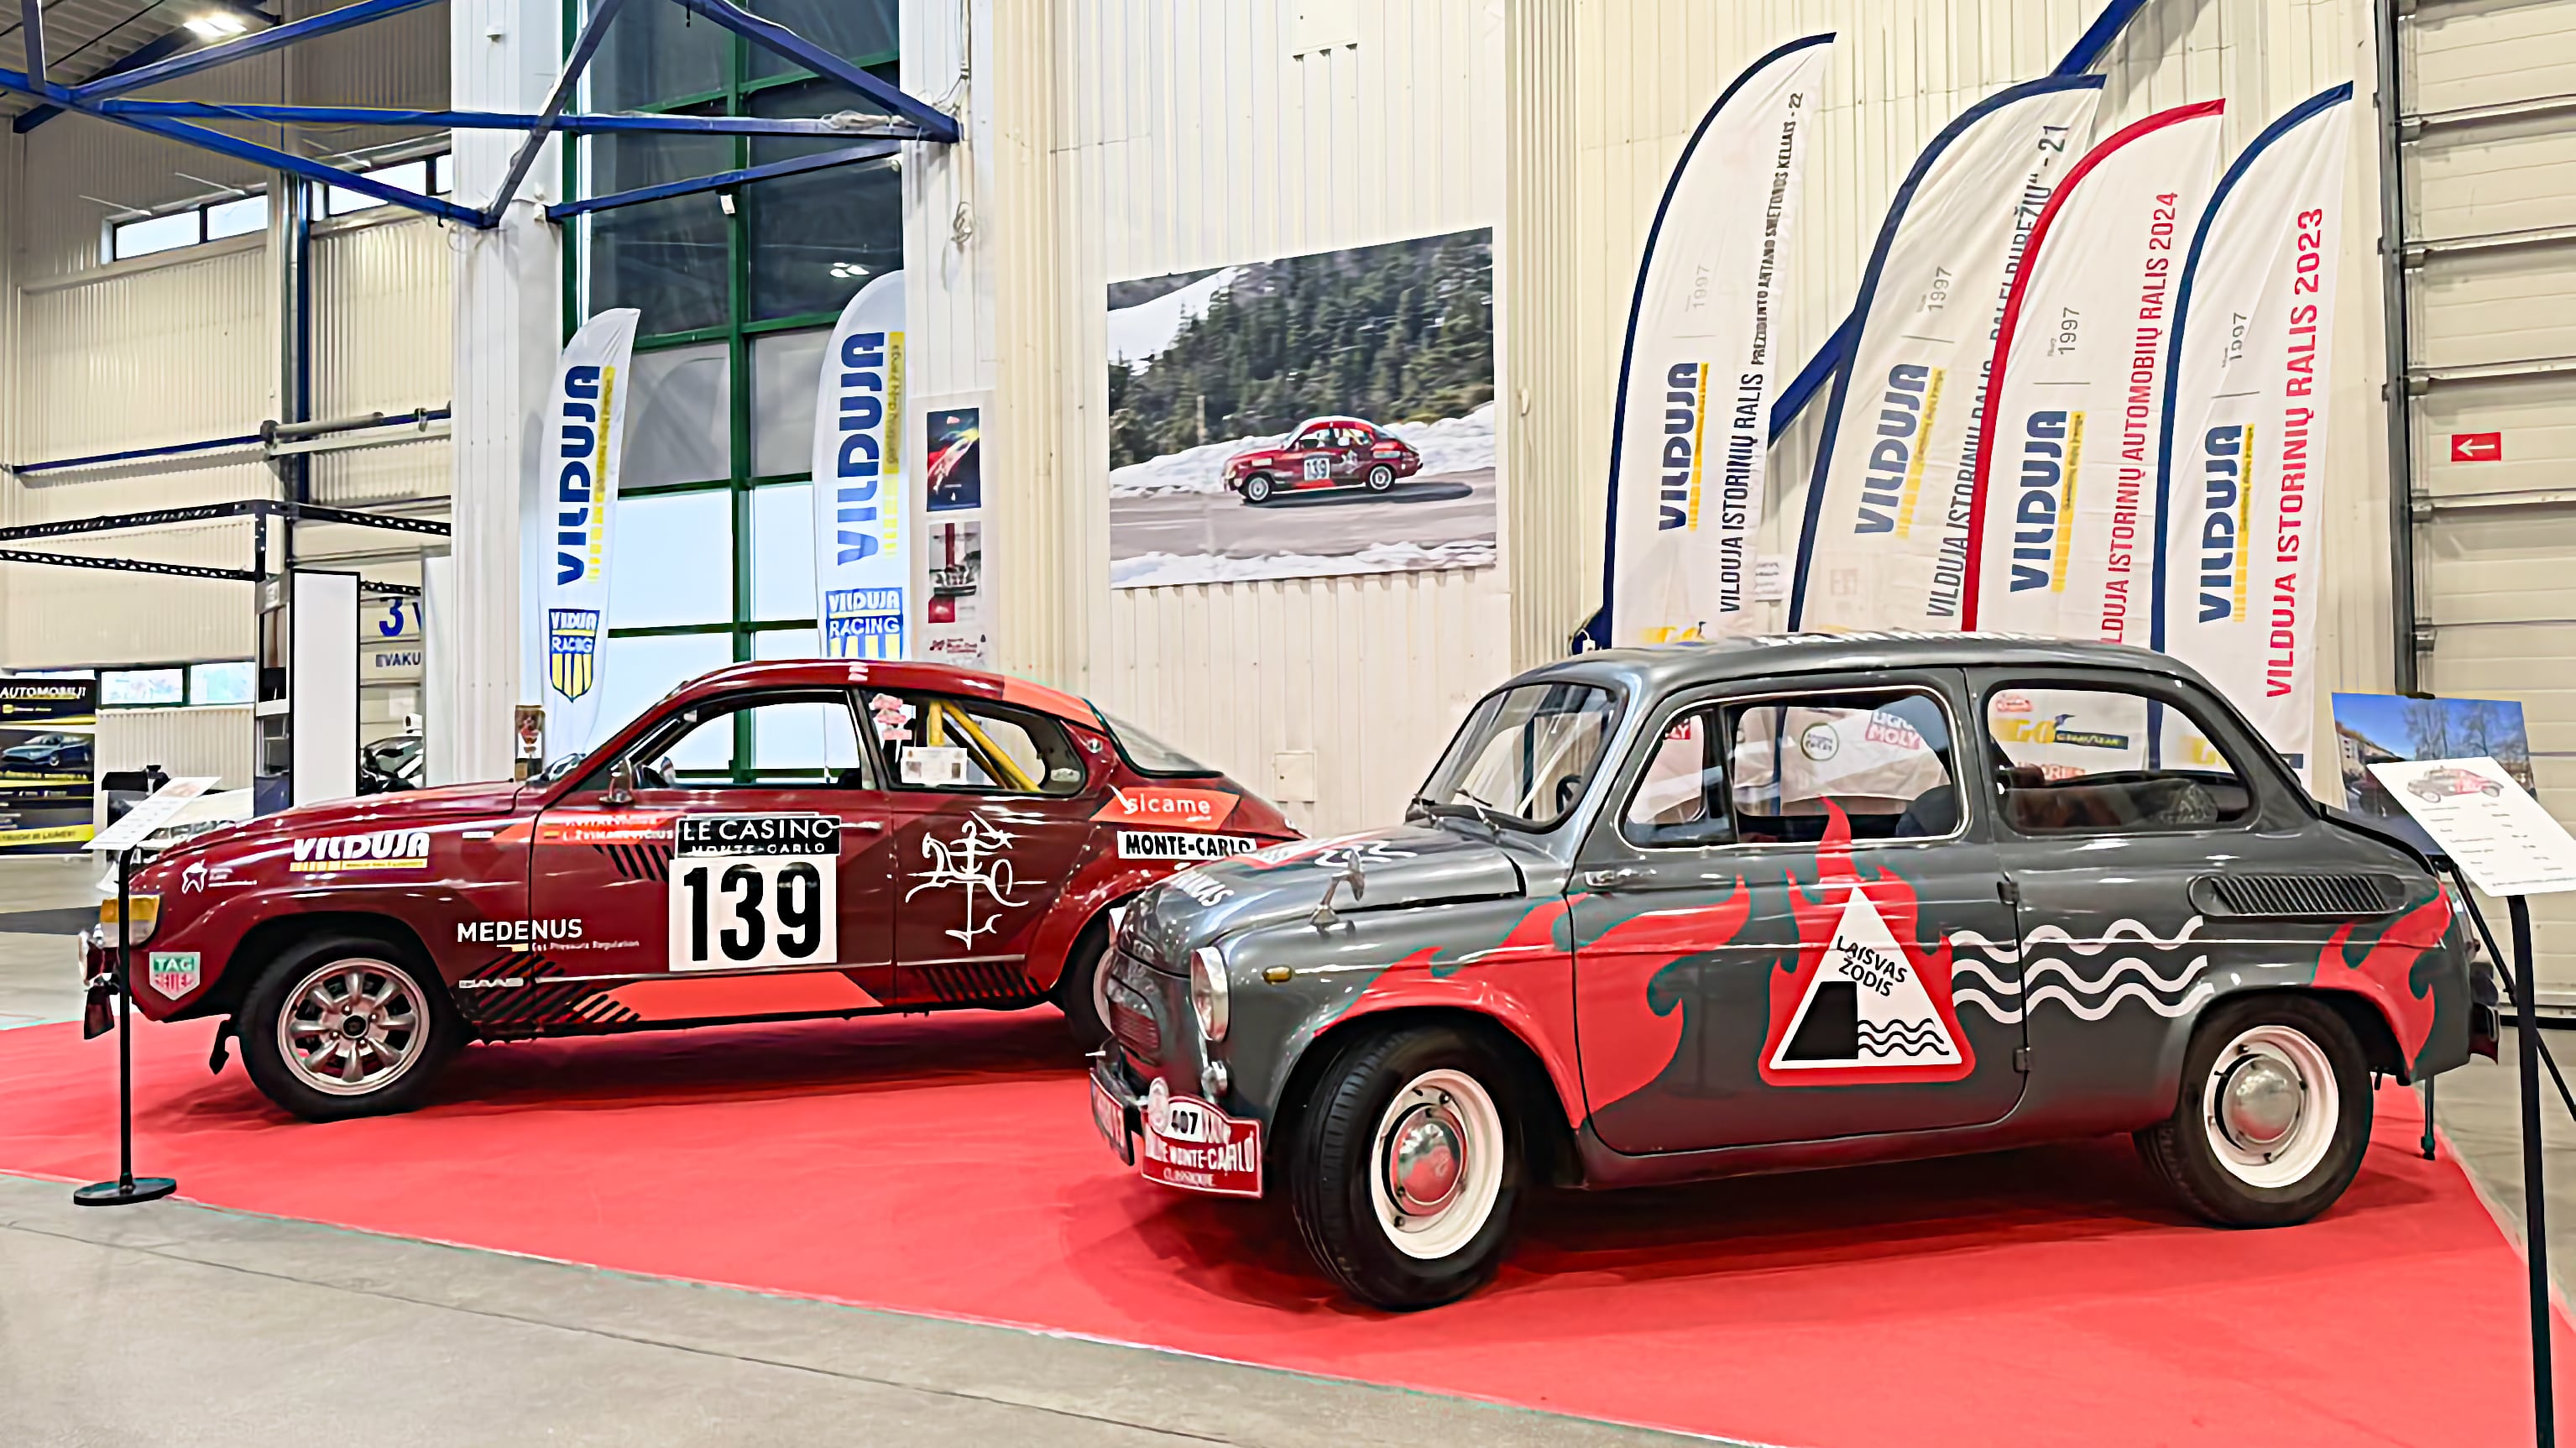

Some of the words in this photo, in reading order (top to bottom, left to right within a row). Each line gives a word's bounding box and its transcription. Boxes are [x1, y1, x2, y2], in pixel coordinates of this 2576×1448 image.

[2038, 126, 2069, 152] 21
[2150, 192, 2178, 250] 2024
[2294, 208, 2323, 295] 2023
[1927, 266, 1952, 311] 1997
[2140, 258, 2169, 319] RALIS
[2058, 307, 2080, 355] 1997
[2286, 305, 2317, 396] RALIS
[557, 365, 600, 586] VILDUJA
[837, 332, 885, 566] VILDUJA
[1659, 363, 1698, 531] VILDUJA
[1854, 363, 1930, 534] VILDUJA
[2276, 407, 2314, 562] ISTORINIŲ
[1721, 537, 1743, 612] VILDUJA
[1734, 374, 1763, 429] RALIS
[2009, 410, 2067, 593] VILDUJA
[2199, 425, 2242, 624] VILDUJA
[1926, 537, 1967, 616] VILDUJA
[379, 598, 404, 637] 3
[829, 617, 900, 637] RACING
[2266, 572, 2297, 697] VILDUJA
[684, 822, 711, 840] LE
[719, 818, 833, 840] CASINO
[1126, 834, 1251, 857] MONTE-CARLO
[457, 919, 582, 942] MEDENUS
[684, 861, 820, 961] 139
[156, 959, 193, 971] TAG
[1837, 935, 1908, 983] LAISVAS
